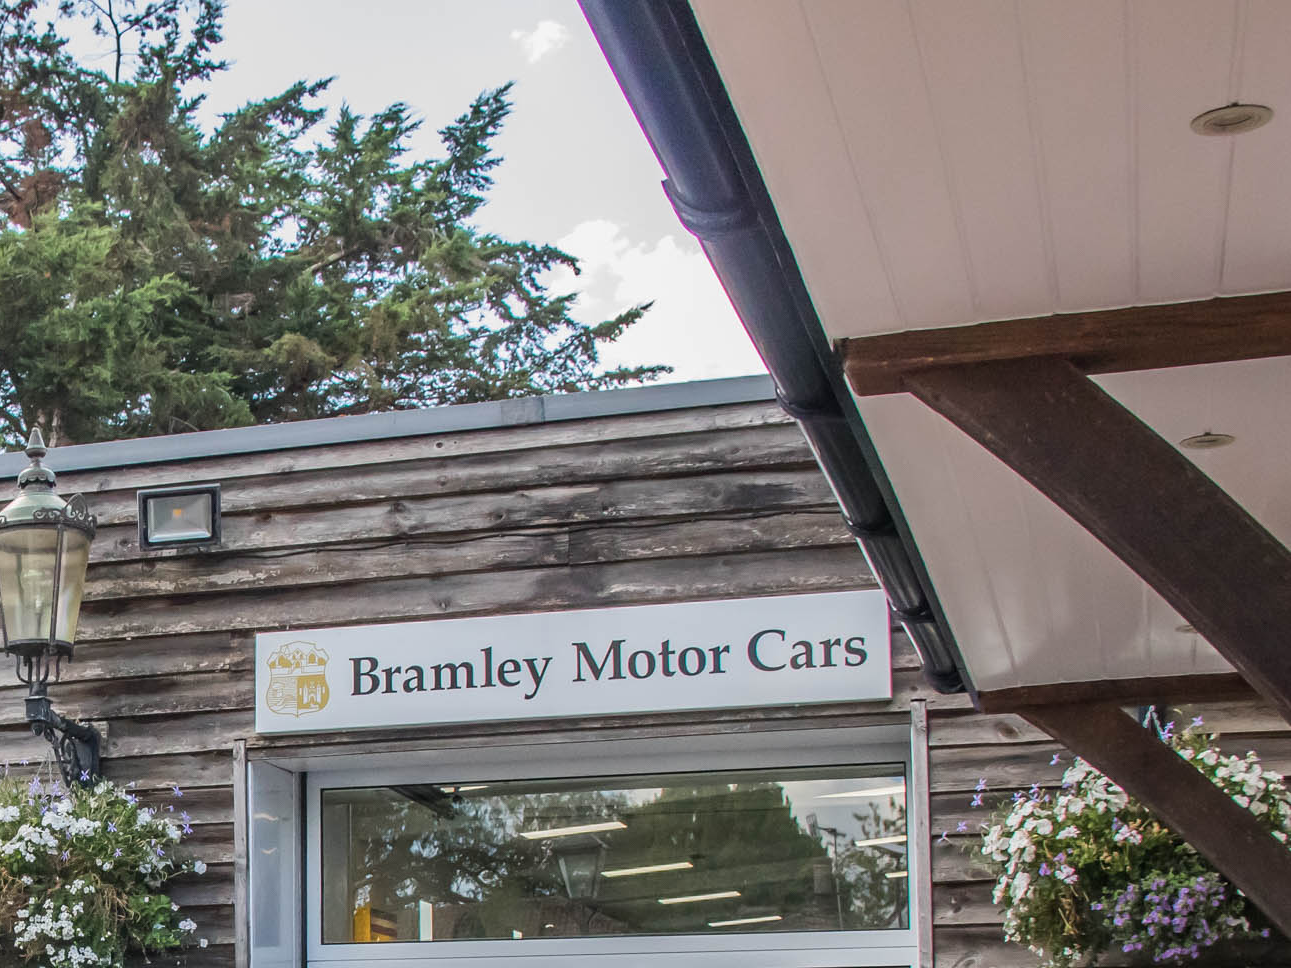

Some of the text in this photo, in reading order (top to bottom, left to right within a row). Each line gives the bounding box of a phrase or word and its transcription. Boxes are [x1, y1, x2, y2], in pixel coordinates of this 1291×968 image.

[349, 629, 868, 700] Bramley Motor Cars
